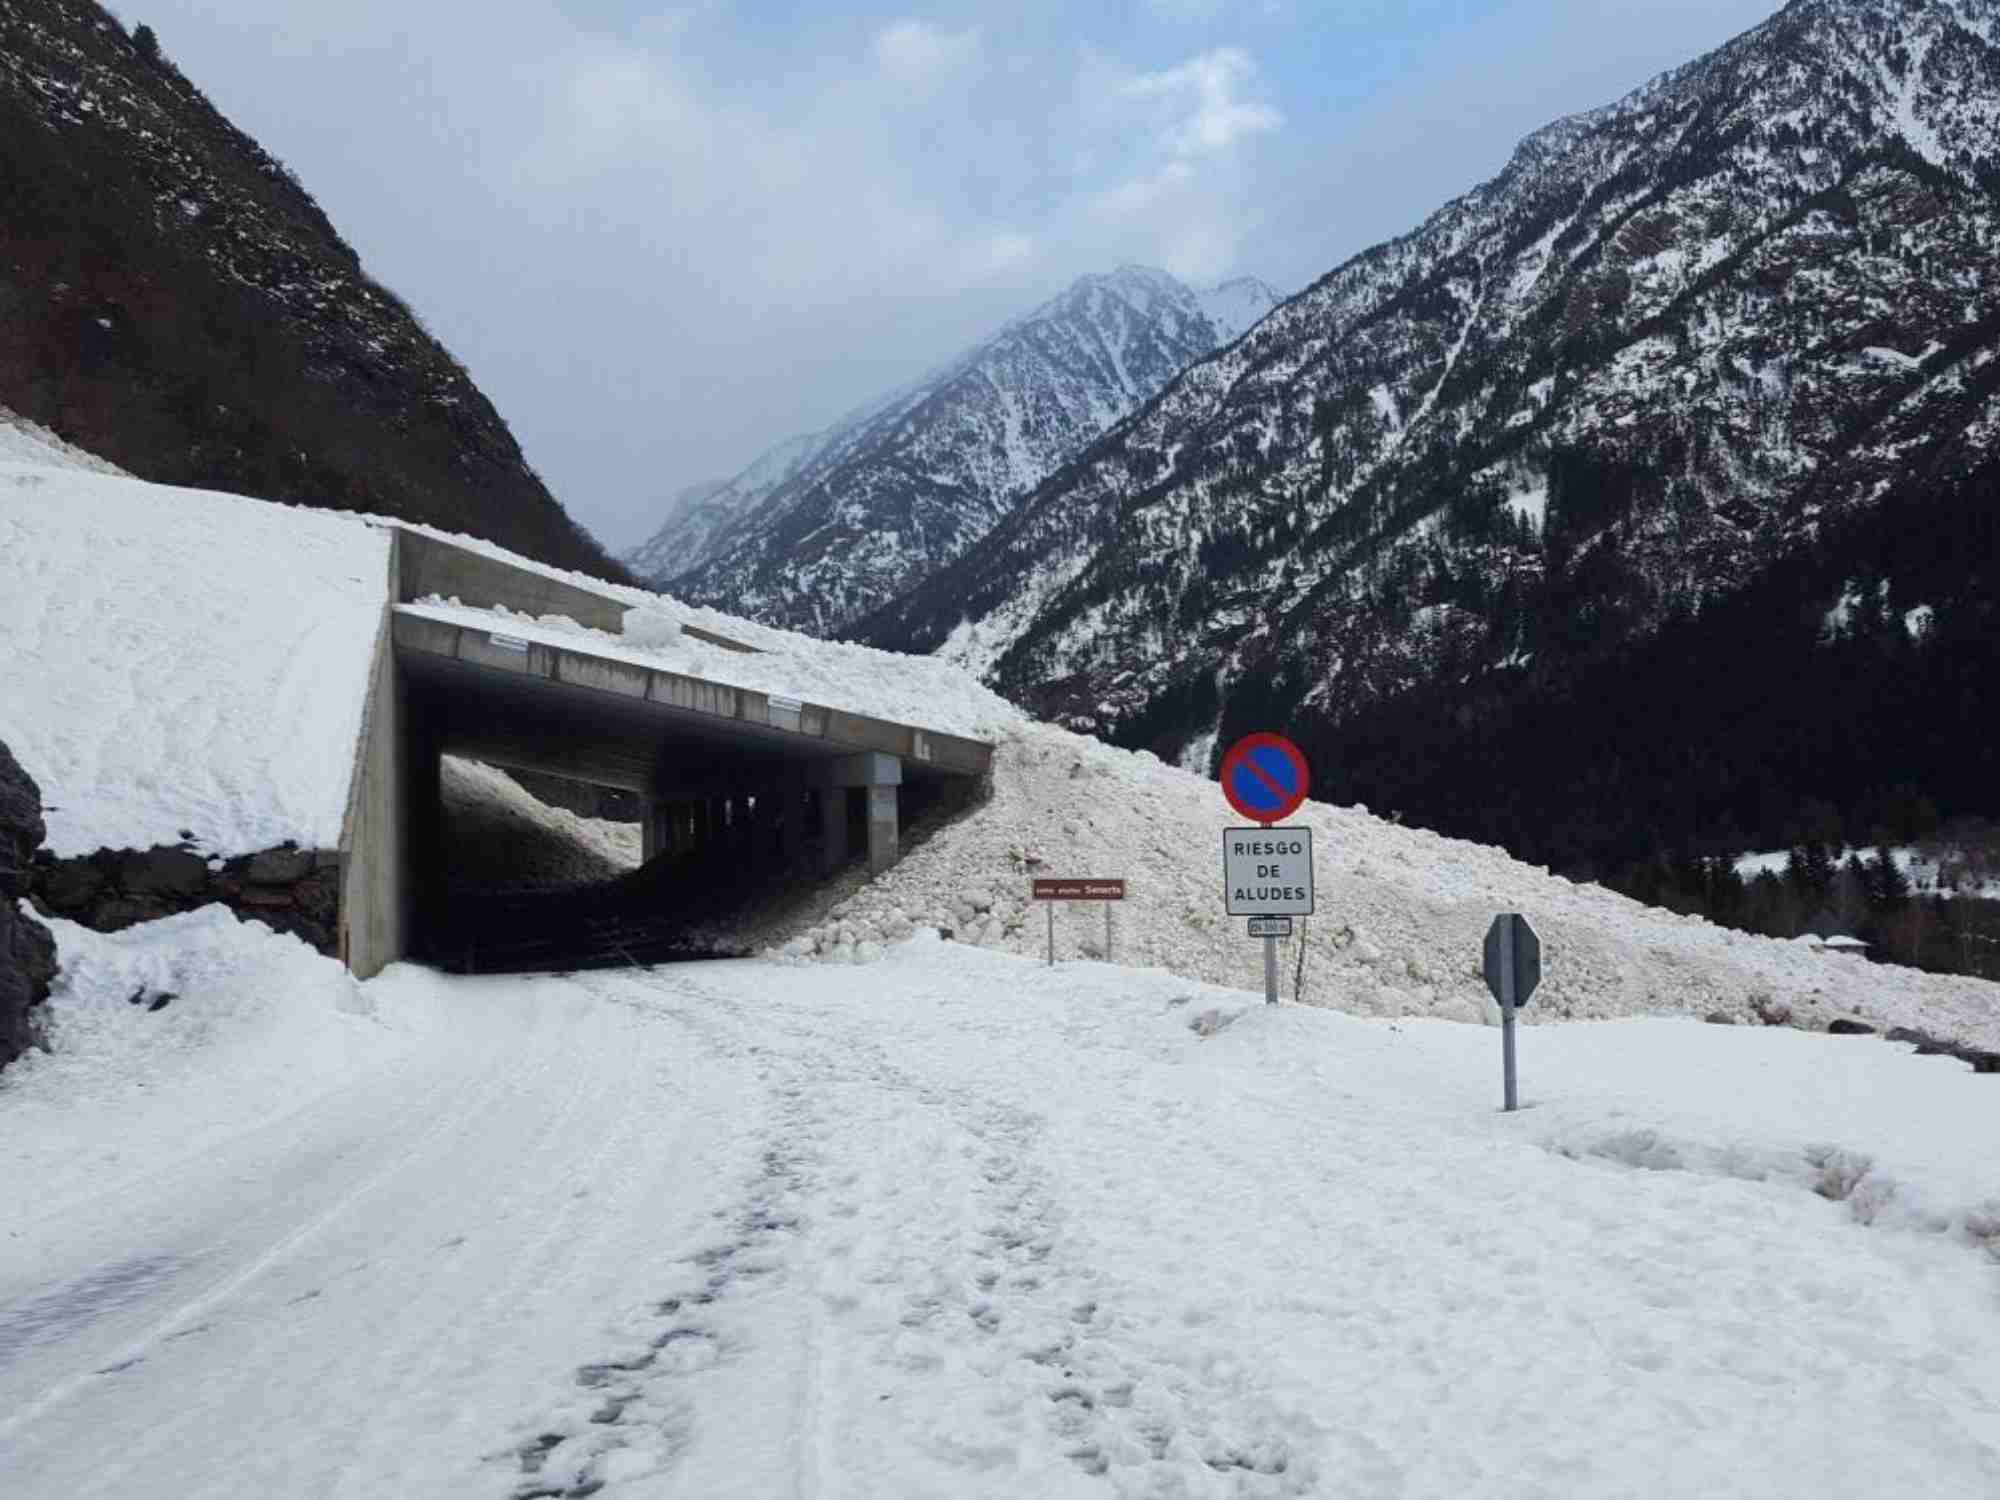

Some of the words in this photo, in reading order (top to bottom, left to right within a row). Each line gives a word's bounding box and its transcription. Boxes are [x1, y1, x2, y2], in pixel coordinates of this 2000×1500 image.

[1234, 842, 1302, 855] RIESGO
[1257, 865, 1280, 878] DE
[1235, 887, 1305, 900] ALUDES
